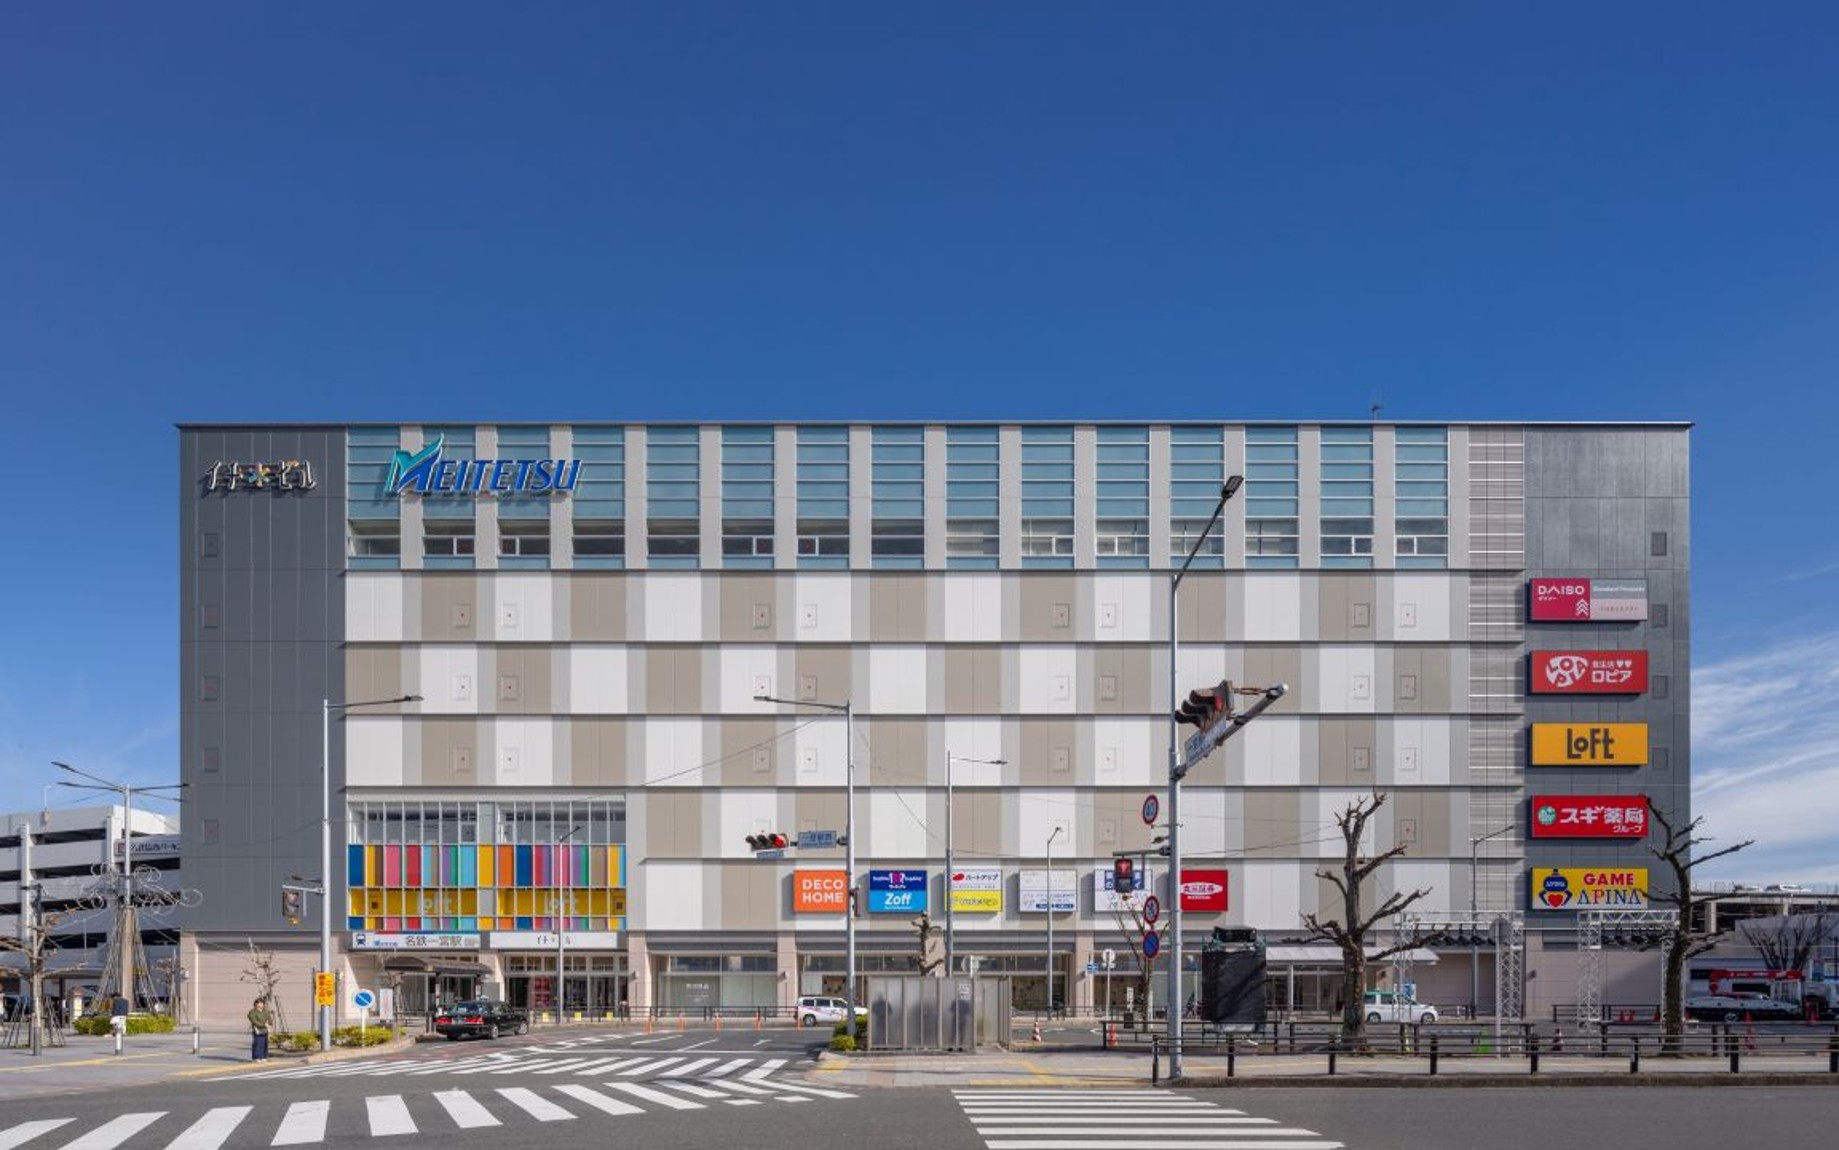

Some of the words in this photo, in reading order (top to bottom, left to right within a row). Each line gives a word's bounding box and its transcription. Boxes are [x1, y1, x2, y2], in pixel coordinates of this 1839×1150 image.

[384, 432, 582, 493] MEITETSU
[1538, 585, 1585, 595] DAISO
[1592, 669, 1632, 683] ロピア
[1560, 806, 1644, 824] スギ薬局
[1613, 825, 1644, 833] グループ
[803, 880, 844, 890] DECO
[1584, 873, 1634, 885] GAME
[803, 892, 844, 903] HOME
[885, 892, 913, 906] Zoff
[1577, 889, 1642, 905] APINA
